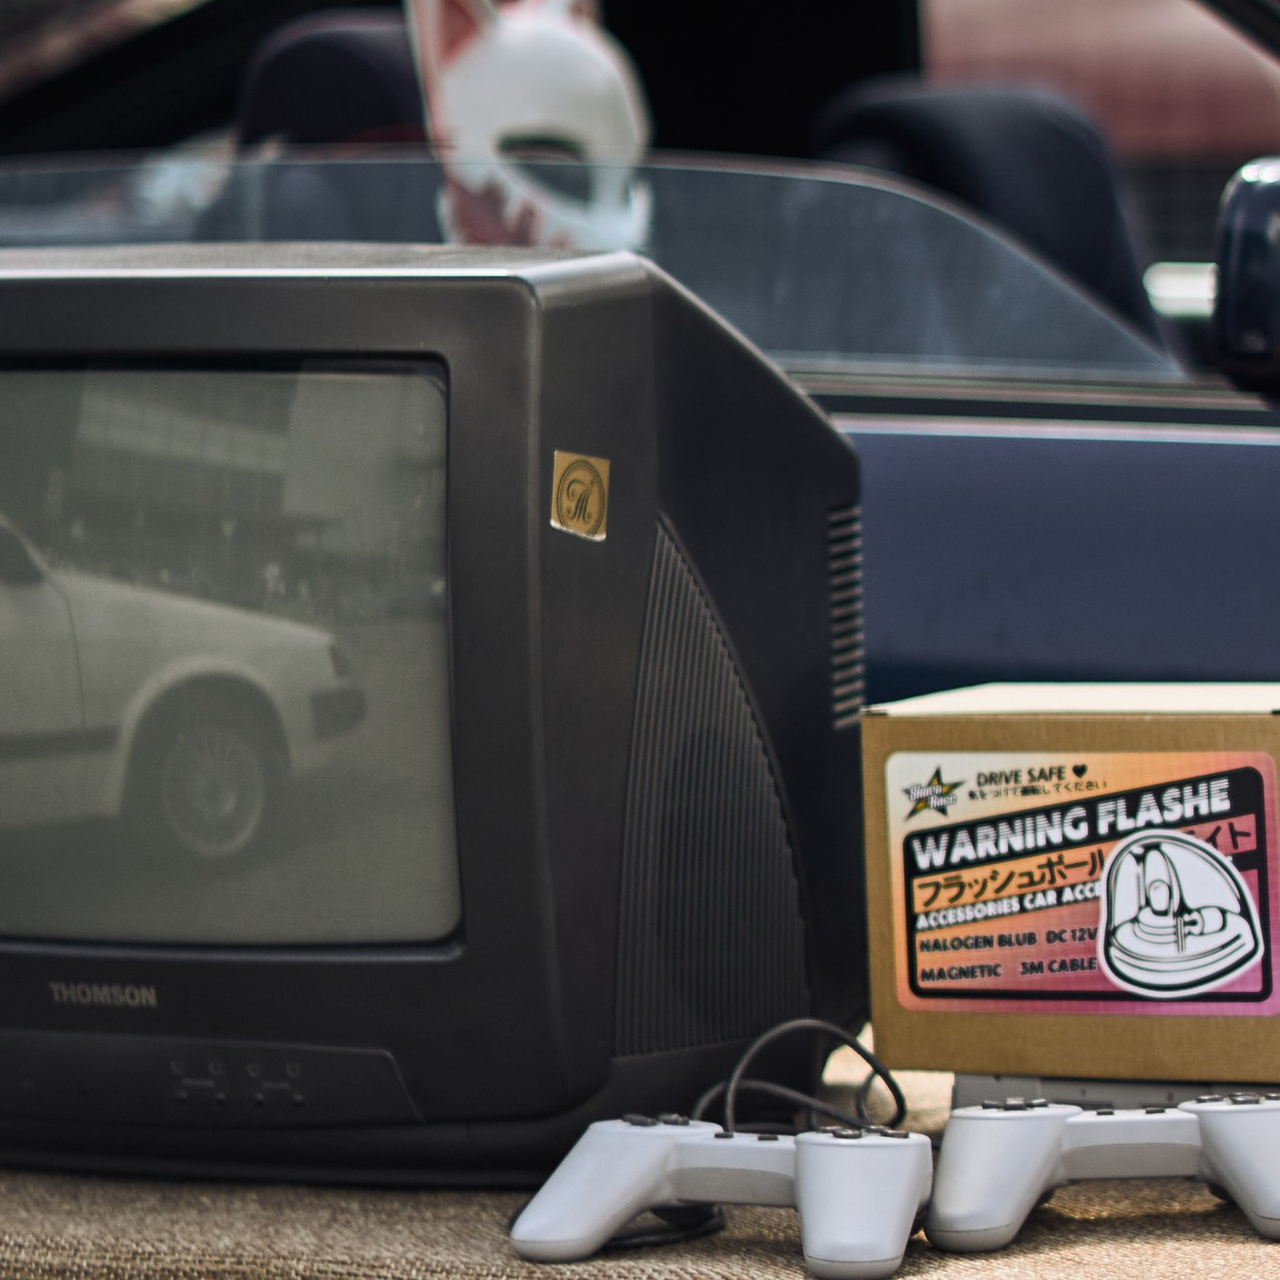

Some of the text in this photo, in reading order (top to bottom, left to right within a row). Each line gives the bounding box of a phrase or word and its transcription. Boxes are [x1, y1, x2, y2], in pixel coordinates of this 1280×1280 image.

[977, 765, 1067, 787] DRIVE SAFE
[911, 777, 1231, 871] WARNING FLASHE
[916, 896, 1020, 930] ACCESSORIES
[1023, 889, 1058, 911] CAR
[919, 926, 1099, 953] HALOGEN BLUB DC 12V
[920, 963, 1002, 983] MAGNETIC
[1048, 957, 1097, 974] CABLE
[49, 981, 157, 1007] THOMSON
